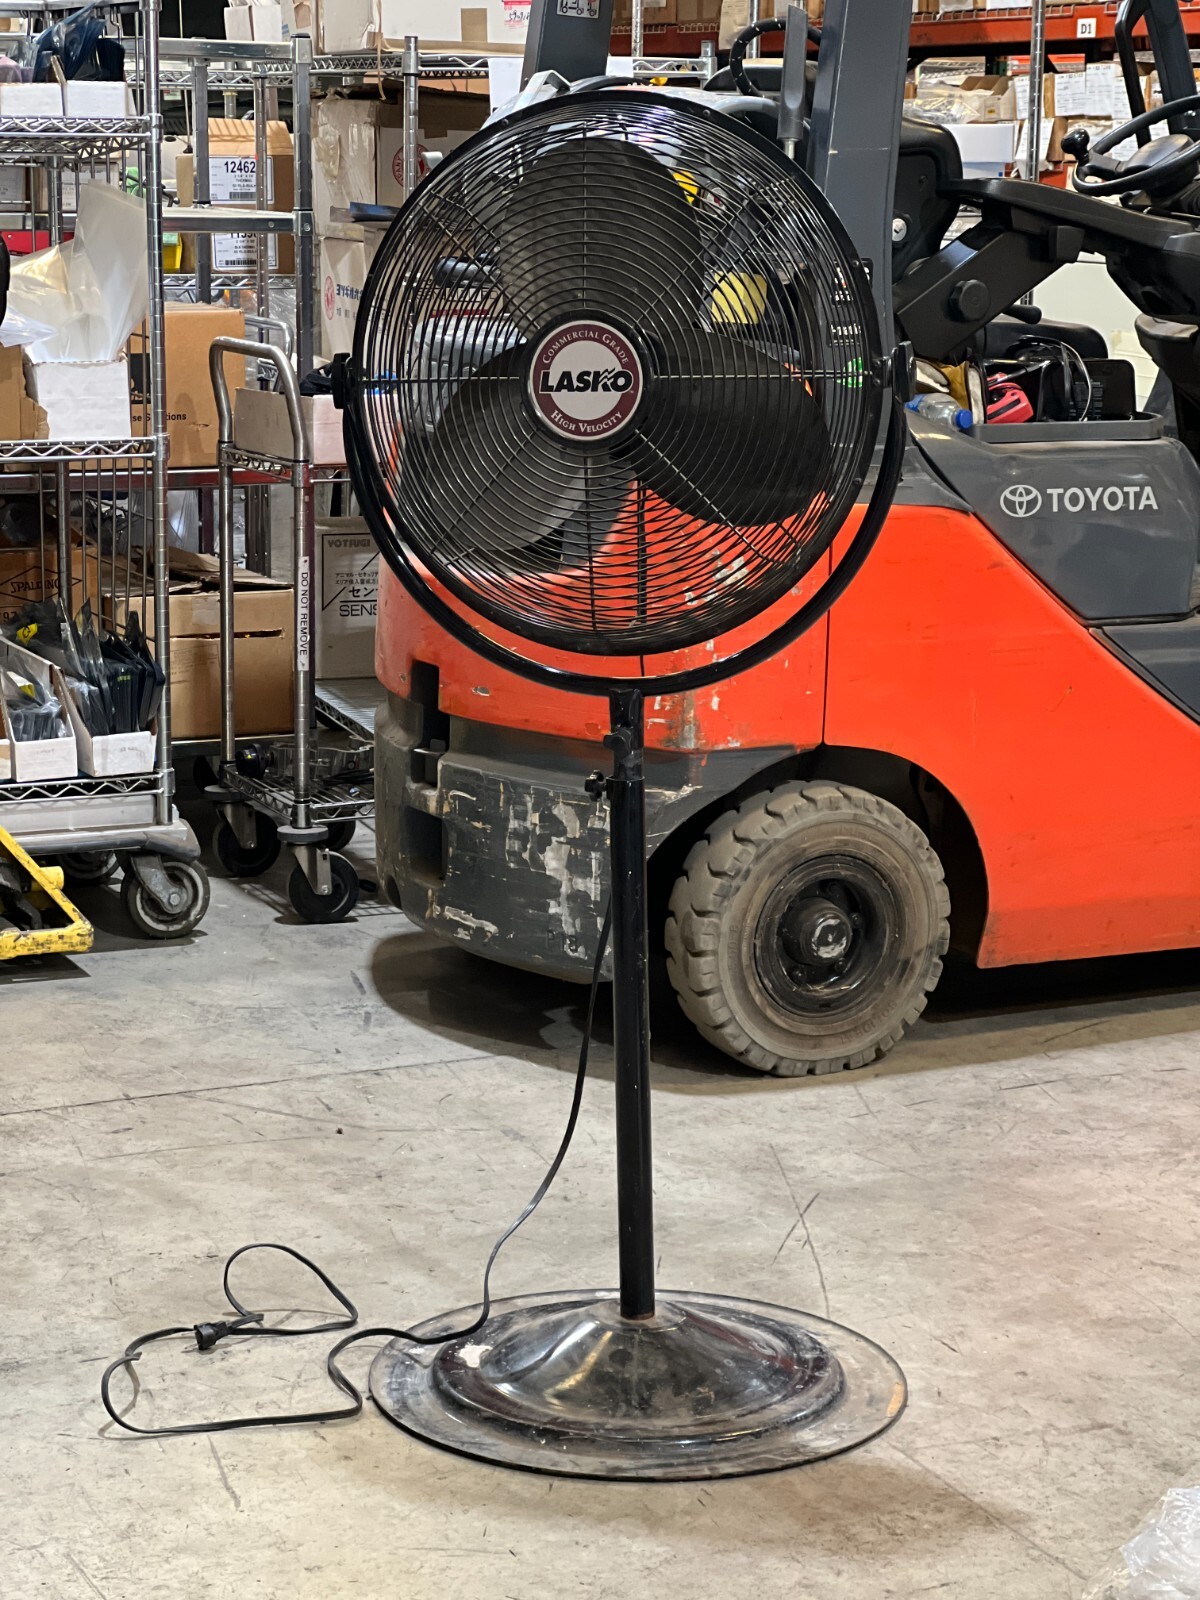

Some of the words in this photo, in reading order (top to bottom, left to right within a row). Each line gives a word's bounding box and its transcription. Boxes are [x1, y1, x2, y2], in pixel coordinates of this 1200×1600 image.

[1080, 23, 1092, 35] D1
[224, 161, 256, 174] 12462
[542, 330, 600, 364] COMMERCIAL
[602, 333, 629, 364] GRADE
[540, 367, 633, 393] LASKO
[551, 410, 576, 431] HIGH
[578, 411, 623, 433] VELOCITY
[1046, 486, 1159, 513] TOYOTA
[301, 571, 309, 587] DO
[301, 590, 309, 609] NOT
[348, 586, 378, 598] セン
[299, 613, 309, 656] REMOVE
